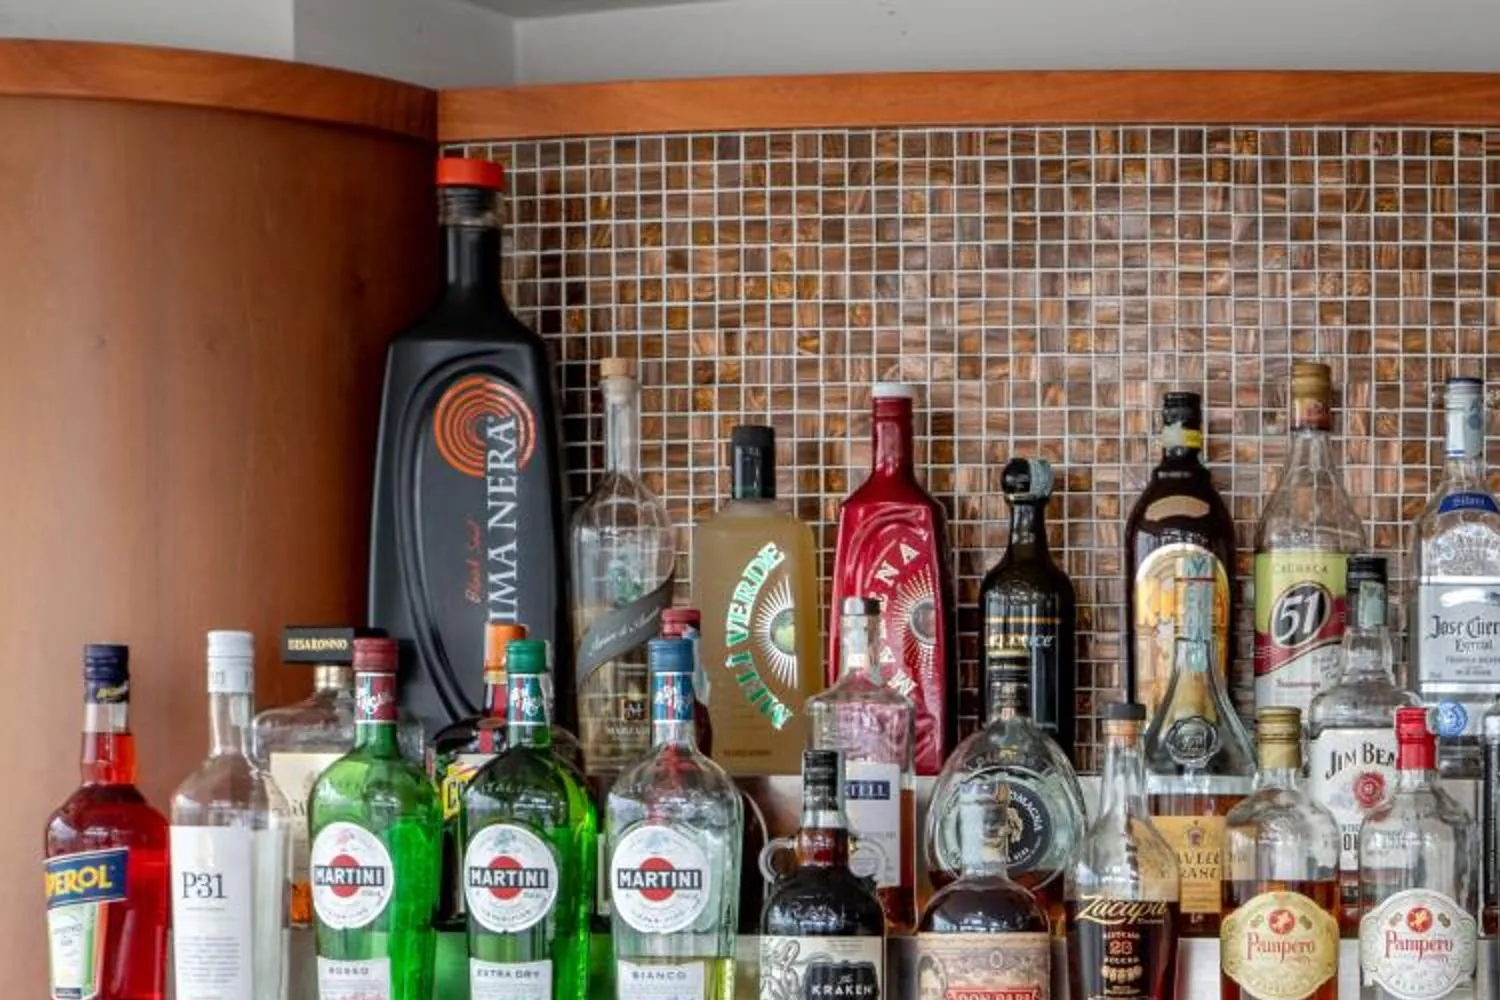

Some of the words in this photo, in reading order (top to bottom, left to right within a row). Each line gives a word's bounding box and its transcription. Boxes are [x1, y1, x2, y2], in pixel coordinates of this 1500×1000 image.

[487, 415, 519, 532] NERA
[725, 541, 786, 647] VERDE
[1275, 591, 1321, 646] 51
[287, 638, 348, 651] DISARONNO
[1324, 747, 1357, 781] JIM
[1362, 742, 1397, 766] BEA
[181, 871, 229, 899] P31
[314, 867, 384, 886] MARTINI
[471, 868, 548, 887] MARTINI
[618, 869, 700, 888] MARTINI
[1074, 893, 1168, 926] Zacapa
[1246, 931, 1315, 963] Pampero
[1384, 930, 1454, 963] Pampero
[477, 968, 512, 978] EXTRA
[515, 969, 540, 978] DRY
[632, 970, 687, 981] BIANCO
[810, 984, 874, 996] KRAKEN
